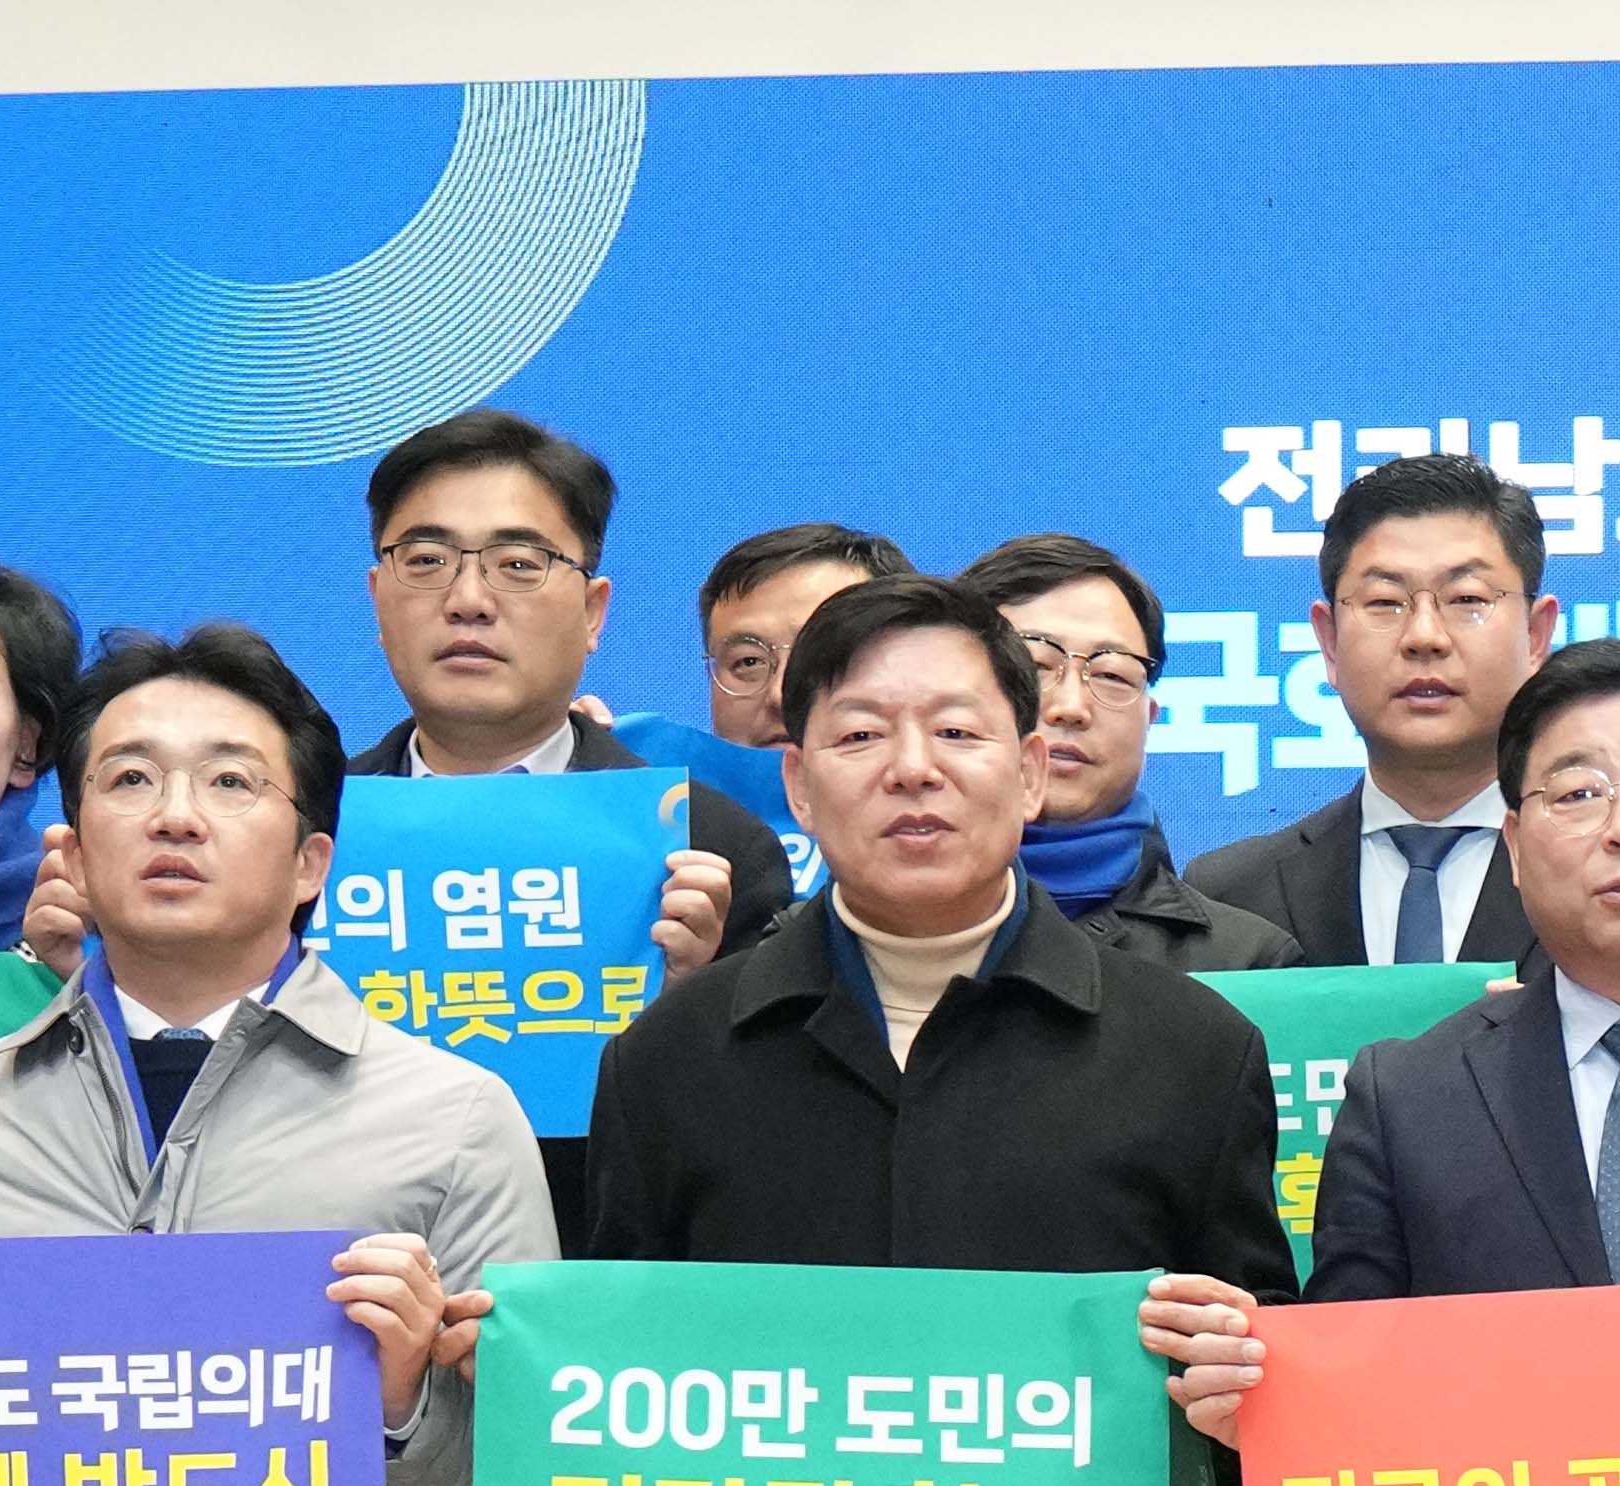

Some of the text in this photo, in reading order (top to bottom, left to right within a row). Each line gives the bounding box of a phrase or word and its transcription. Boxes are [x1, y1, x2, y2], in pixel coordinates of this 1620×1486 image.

[431, 865, 584, 951] 염원
[50, 1344, 334, 1433] 국립의대
[550, 1364, 1093, 1469] 200만 도민의
